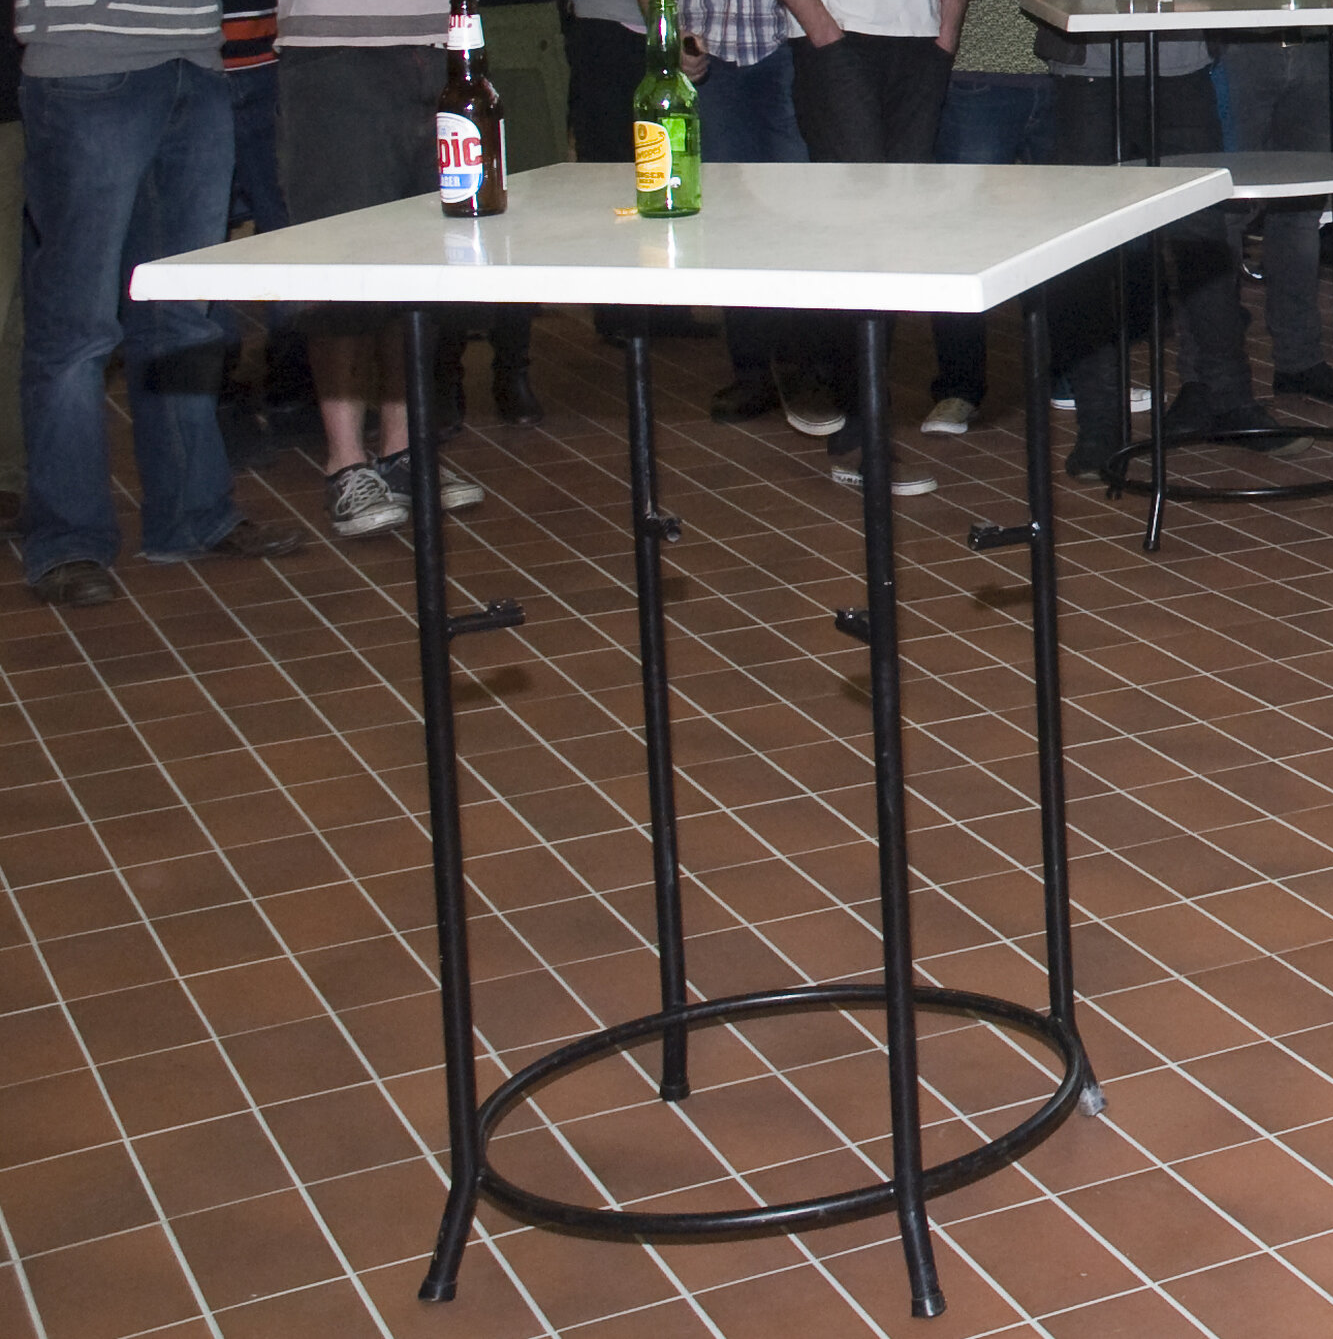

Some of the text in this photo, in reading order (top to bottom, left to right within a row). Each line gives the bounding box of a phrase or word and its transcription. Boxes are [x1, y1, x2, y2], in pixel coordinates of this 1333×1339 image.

[449, 14, 473, 32] pic
[439, 132, 484, 175] pic
[441, 175, 461, 187] AGER
